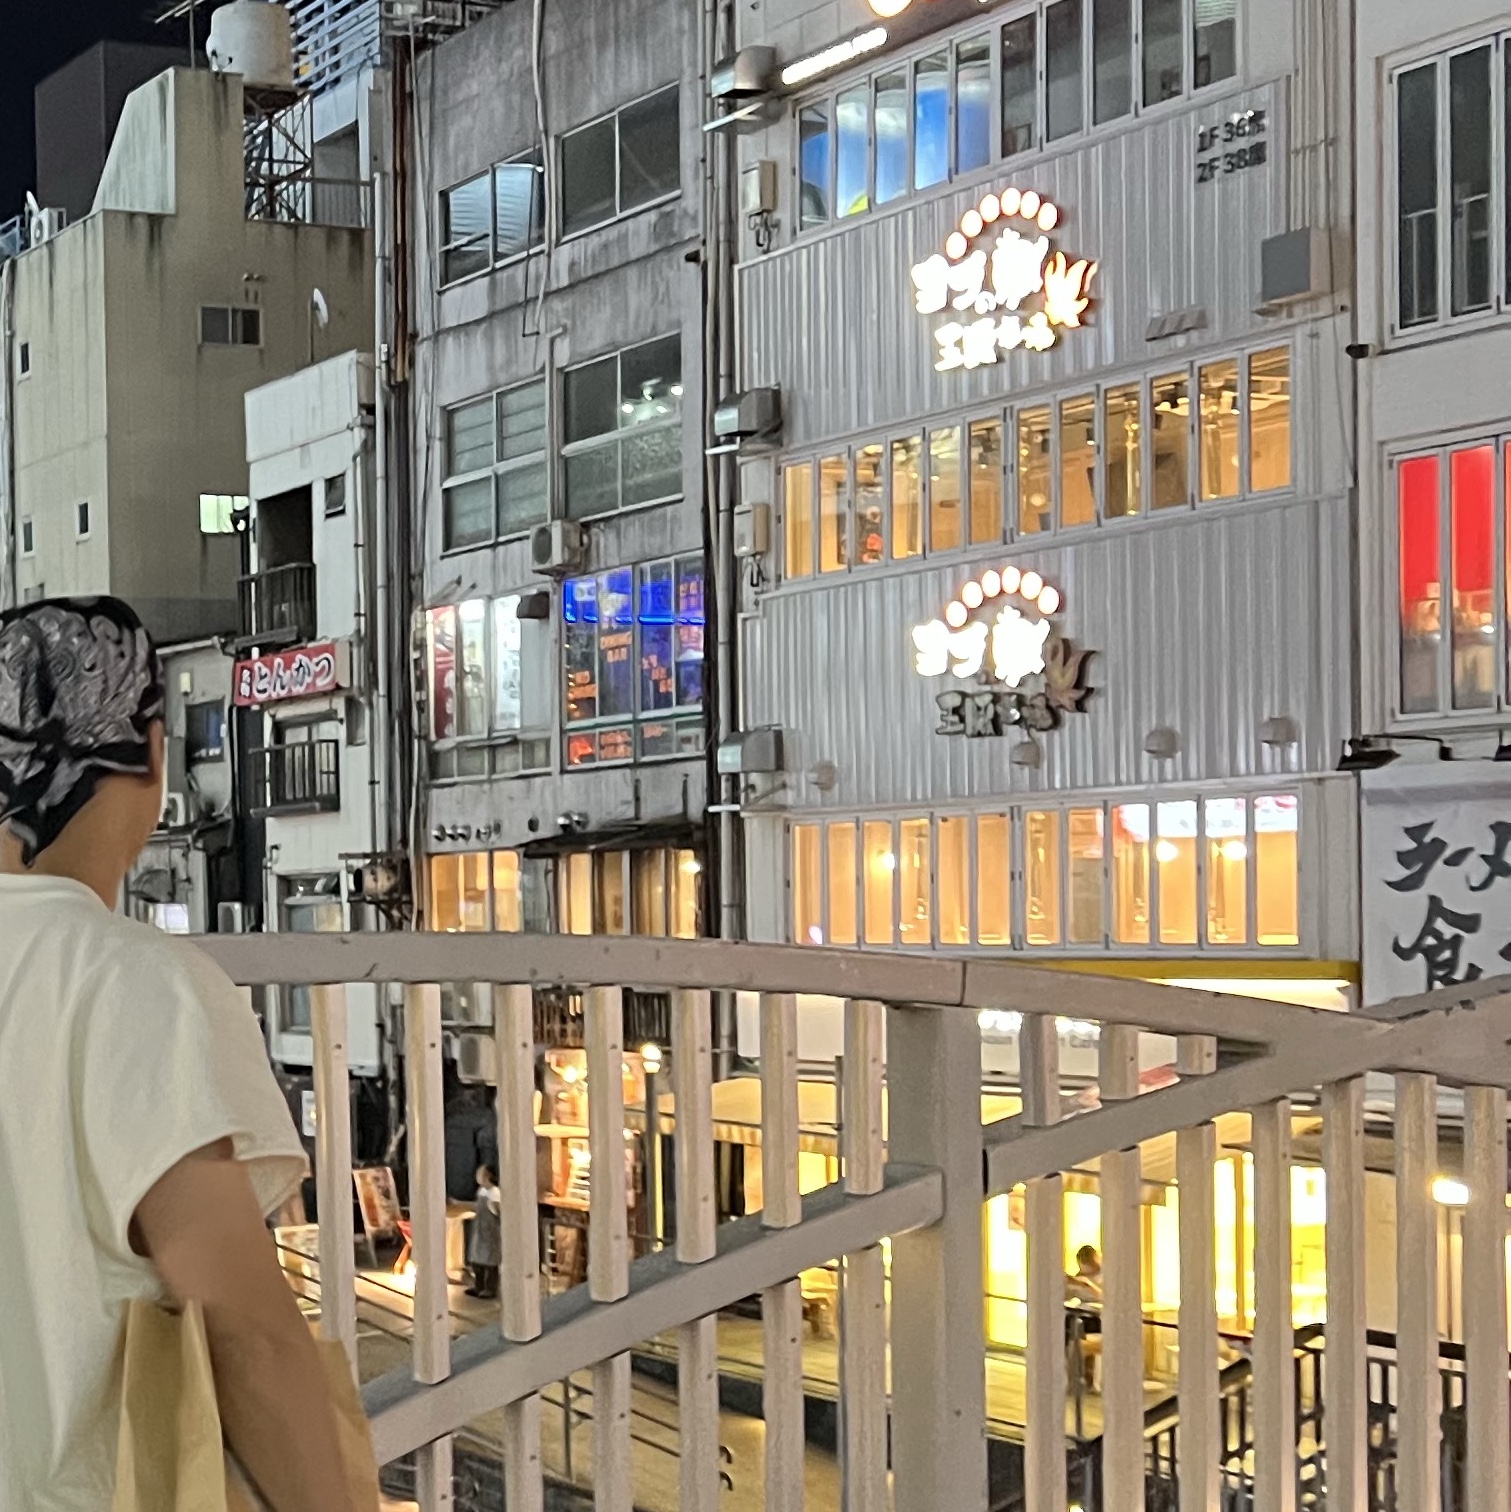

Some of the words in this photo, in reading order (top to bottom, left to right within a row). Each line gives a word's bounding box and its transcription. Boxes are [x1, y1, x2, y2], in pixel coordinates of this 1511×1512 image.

[252, 652, 335, 700] とんかつ
[1392, 894, 1511, 991] 食
